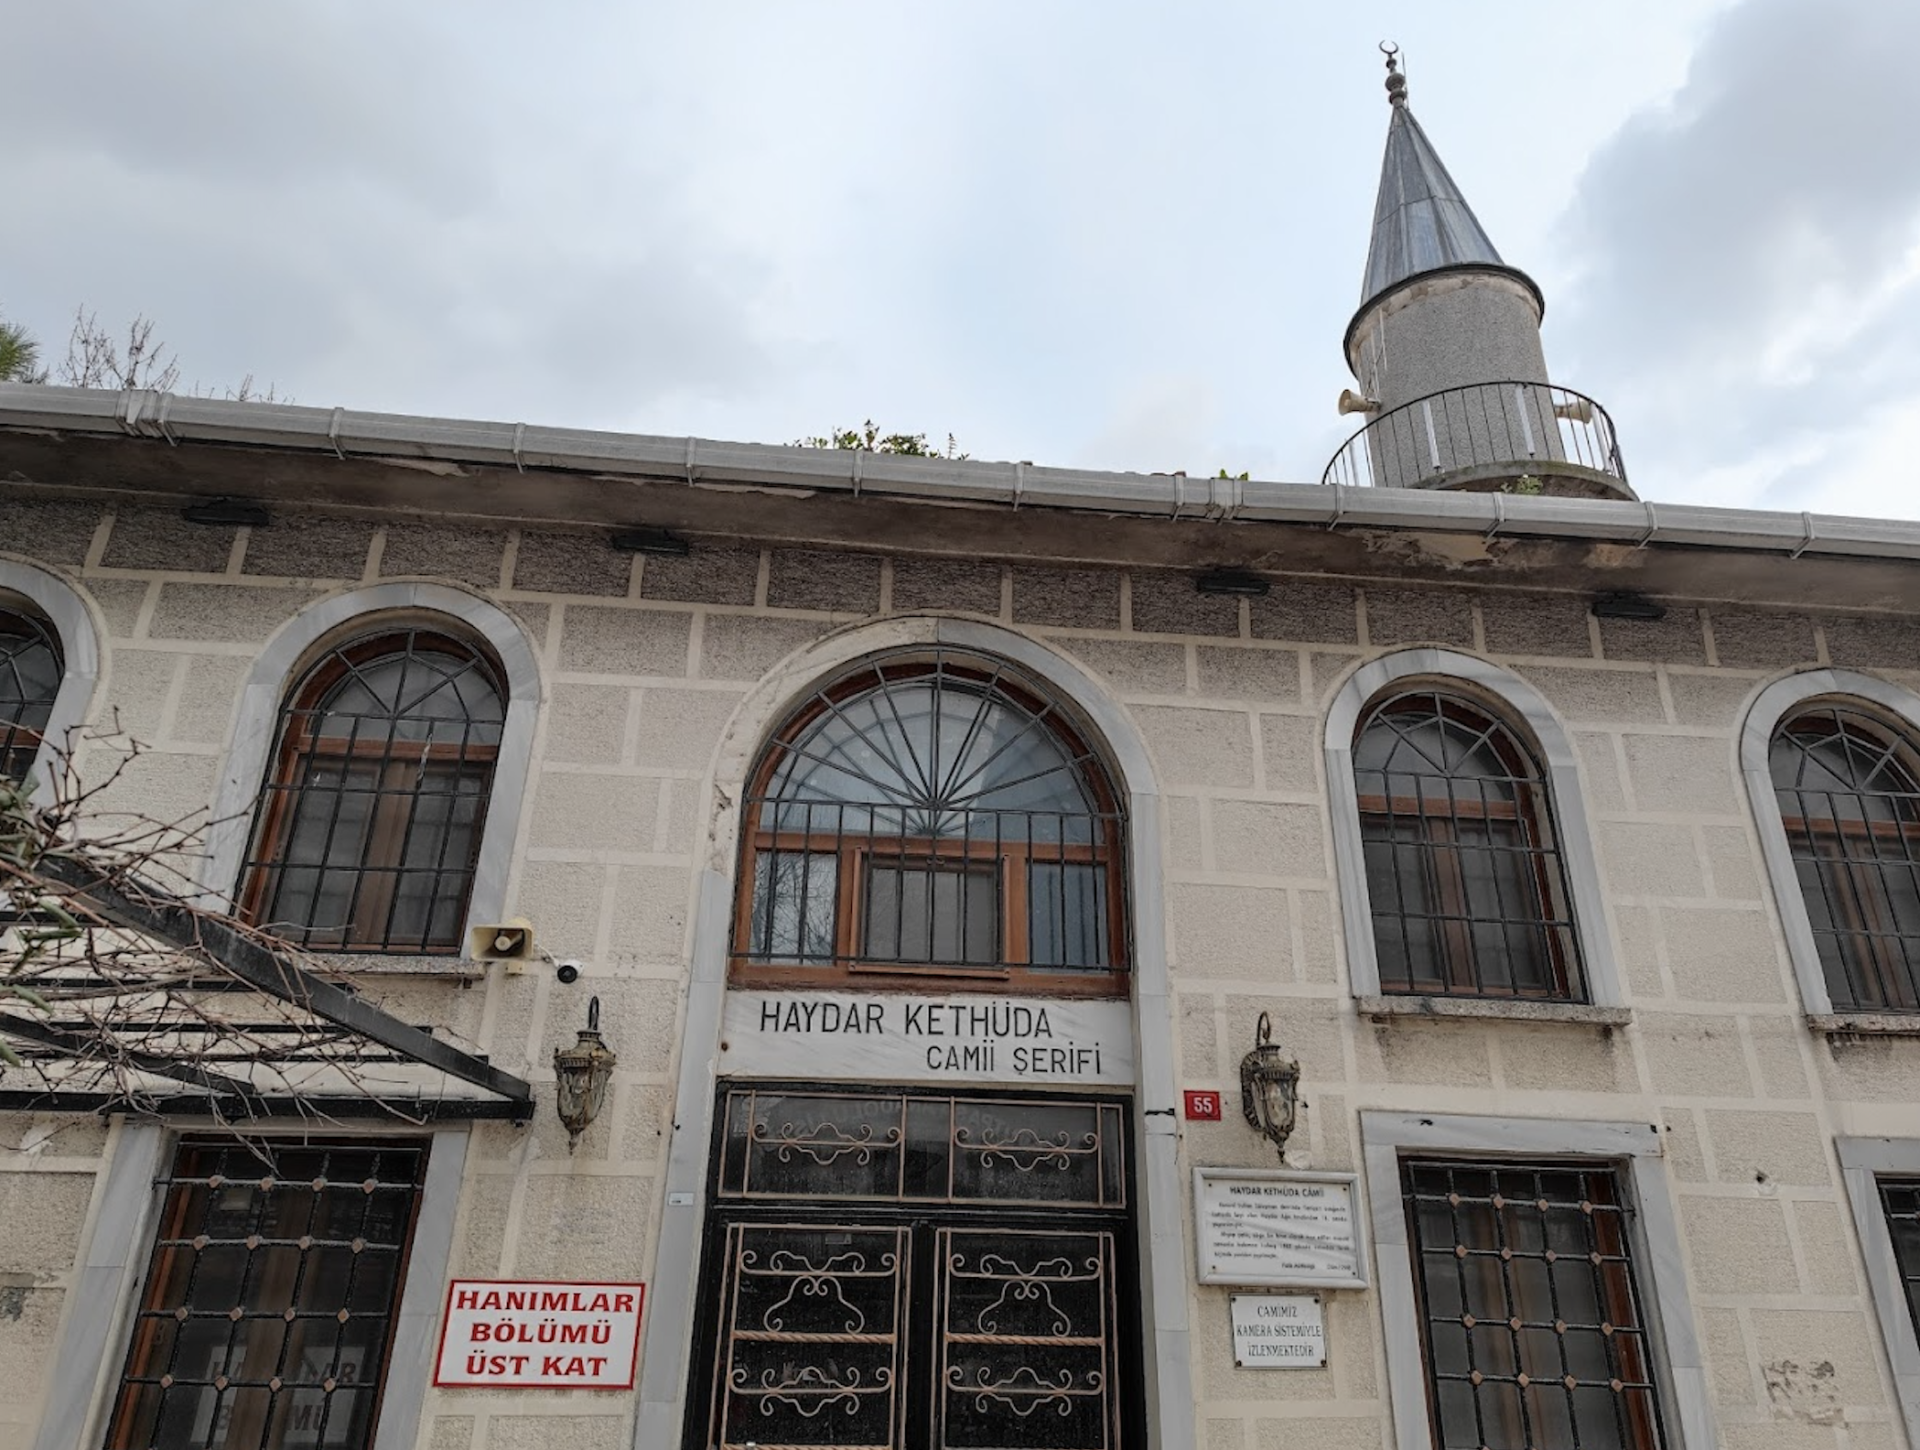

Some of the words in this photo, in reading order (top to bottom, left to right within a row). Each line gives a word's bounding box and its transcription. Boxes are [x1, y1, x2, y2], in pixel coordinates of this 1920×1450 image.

[760, 1001, 884, 1034] HAYDAR
[904, 1002, 1053, 1038] KETHÜDA
[926, 1039, 996, 1072] CAMİİ
[1013, 1041, 1101, 1076] ŞERİFİ
[1193, 1097, 1213, 1113] 55
[1229, 1186, 1261, 1195] HAYDAR
[456, 1290, 634, 1313] HANIMLAR
[470, 1317, 612, 1344] BÖLÜMÜ
[1236, 1324, 1272, 1337] KAMERA
[466, 1350, 529, 1375] ÜST
[541, 1356, 608, 1376] KAT
